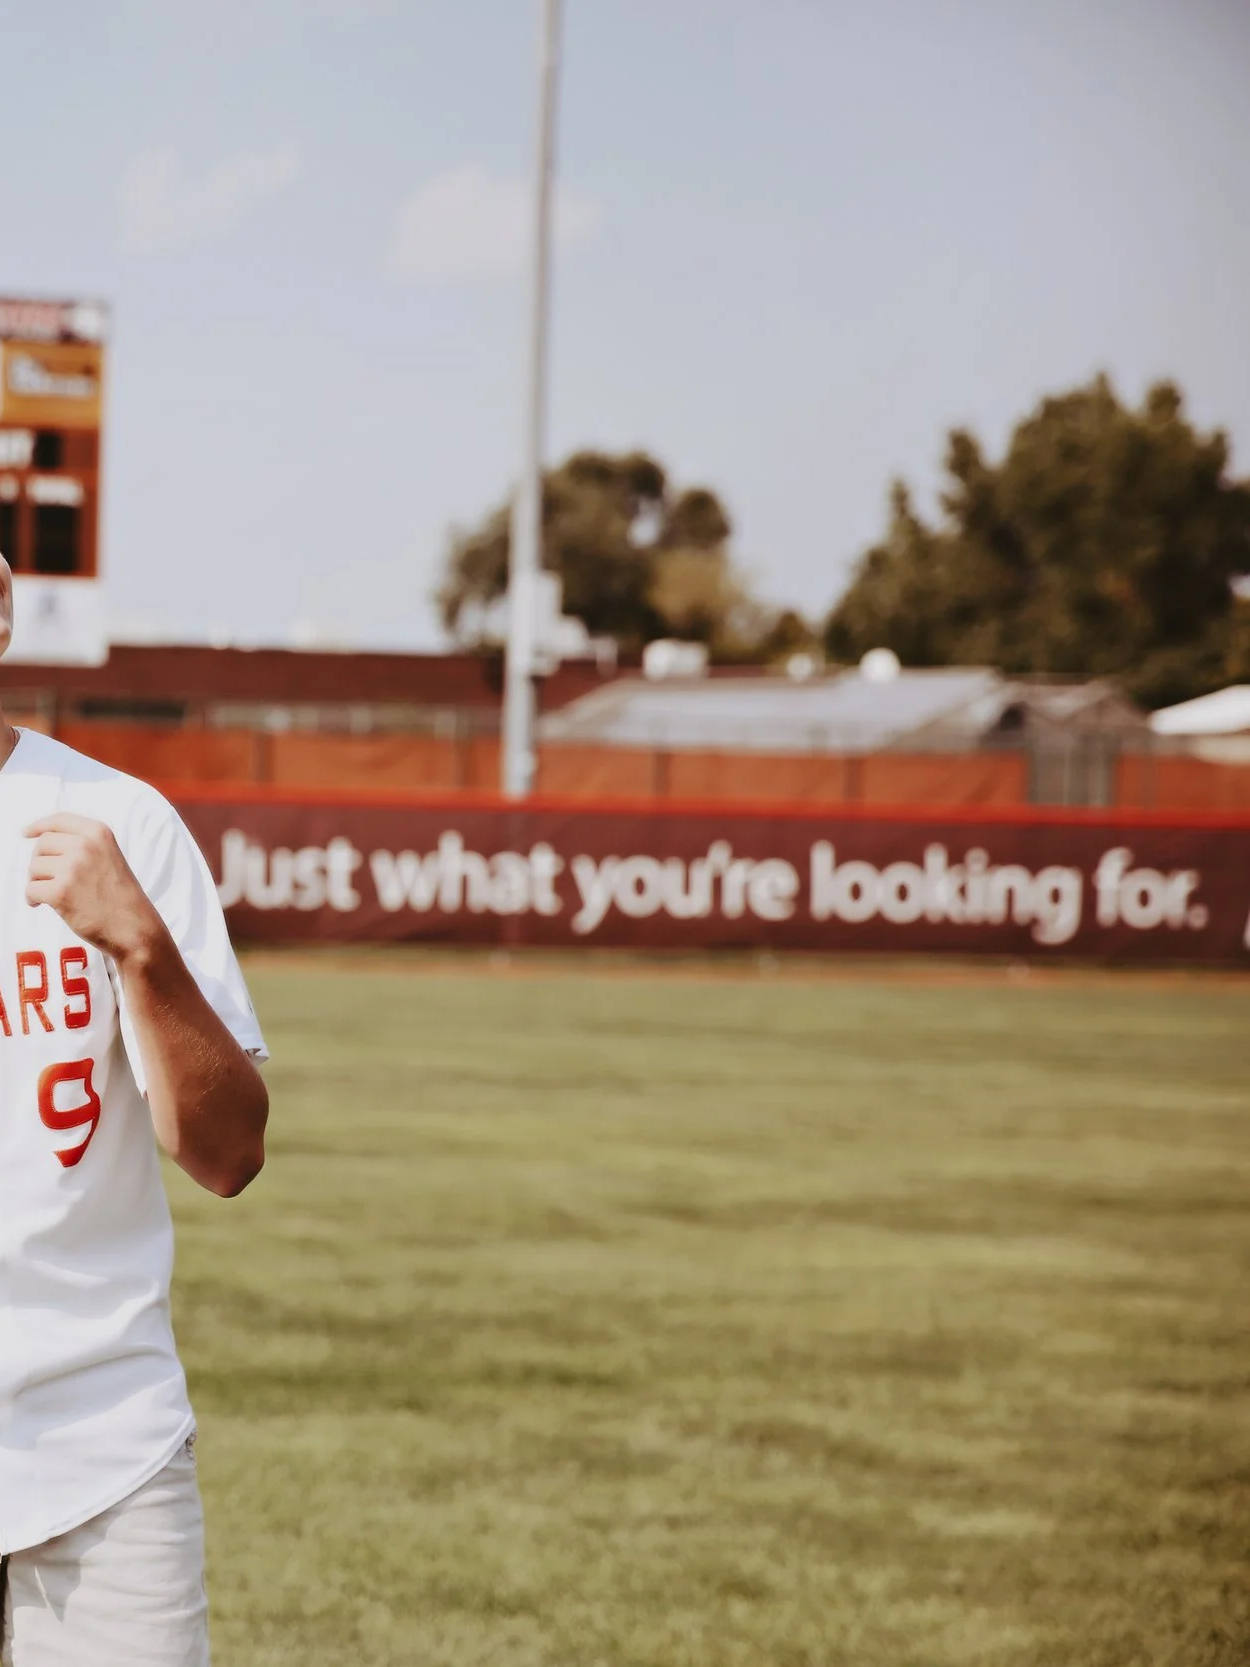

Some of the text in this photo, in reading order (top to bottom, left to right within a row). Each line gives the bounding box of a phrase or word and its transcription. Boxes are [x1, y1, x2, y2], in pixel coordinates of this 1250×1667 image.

[217, 828, 1209, 945] Just what you're looking for.
[37, 1057, 101, 1168] 9
